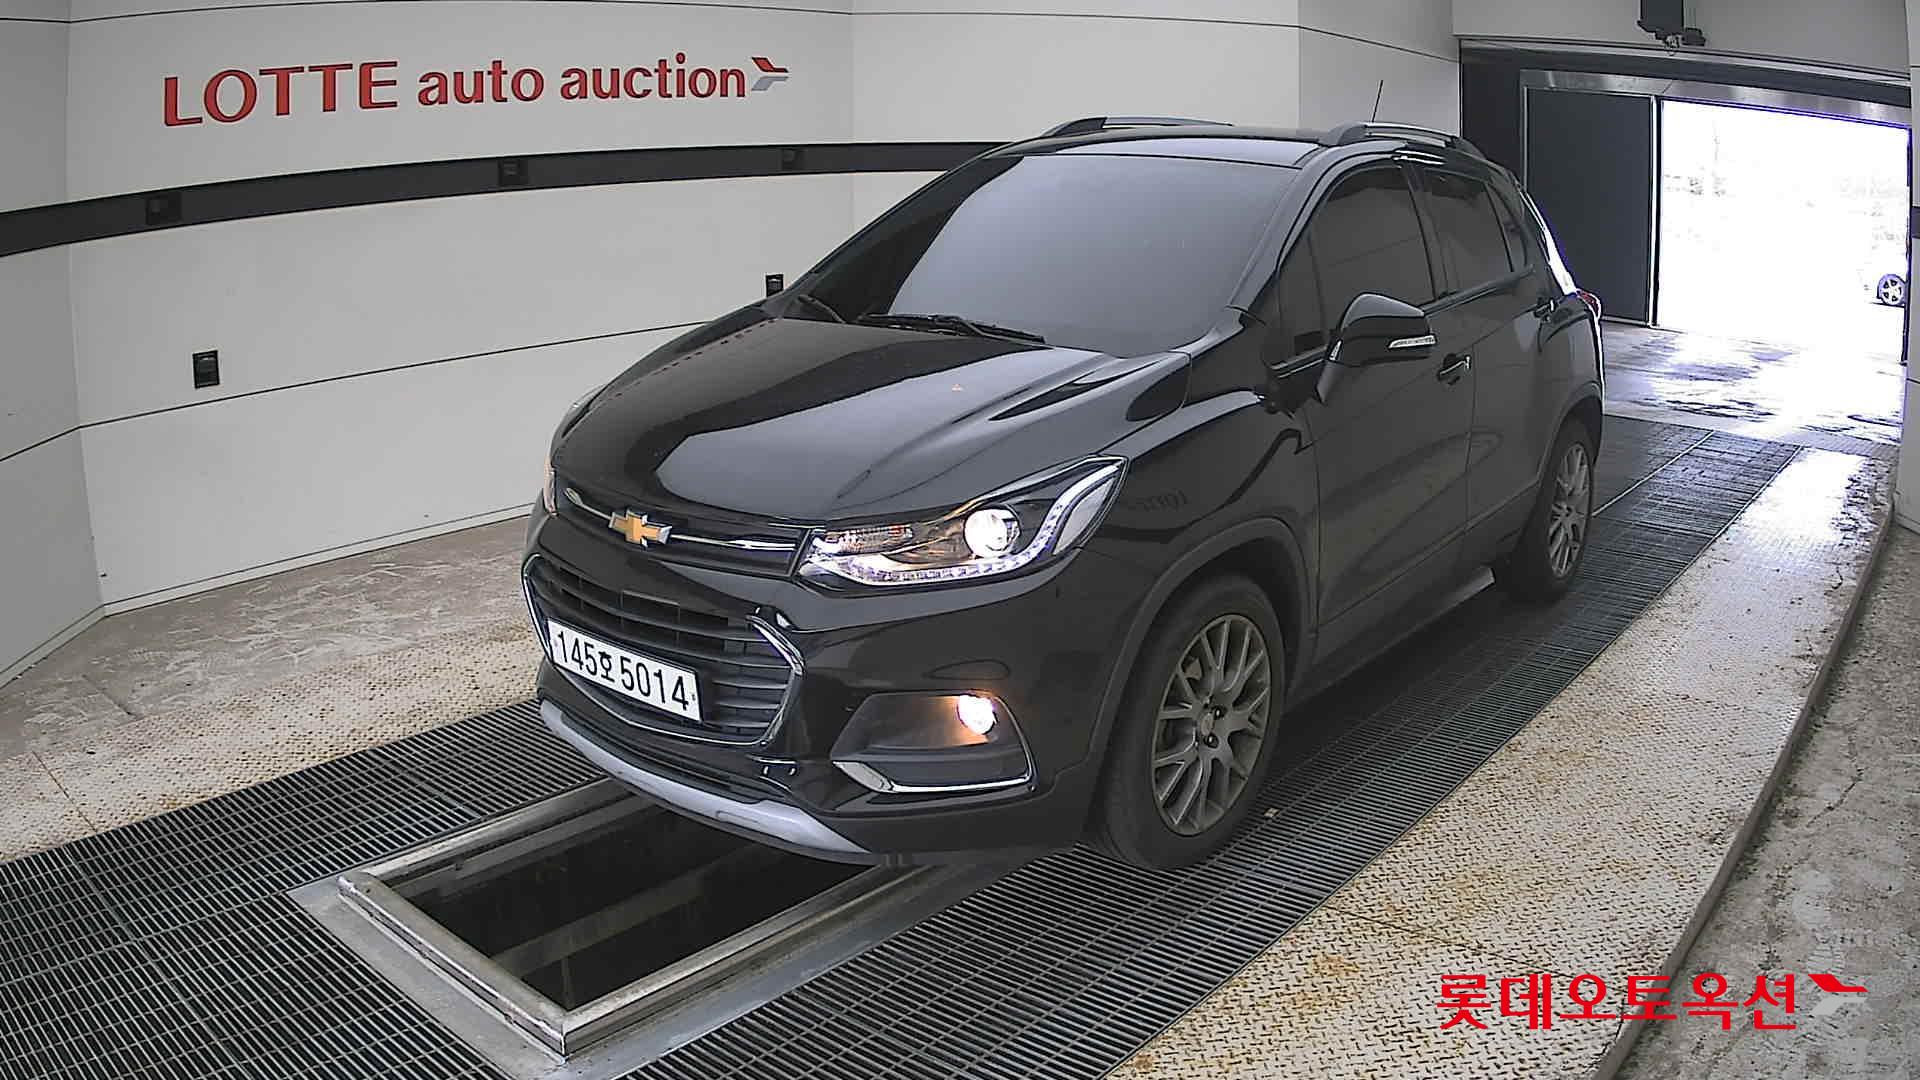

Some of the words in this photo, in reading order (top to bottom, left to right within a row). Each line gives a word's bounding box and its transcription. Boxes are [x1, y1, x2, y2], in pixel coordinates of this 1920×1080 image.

[164, 61, 398, 126] LOTTE
[417, 60, 545, 105] auto
[560, 52, 746, 99] auction
